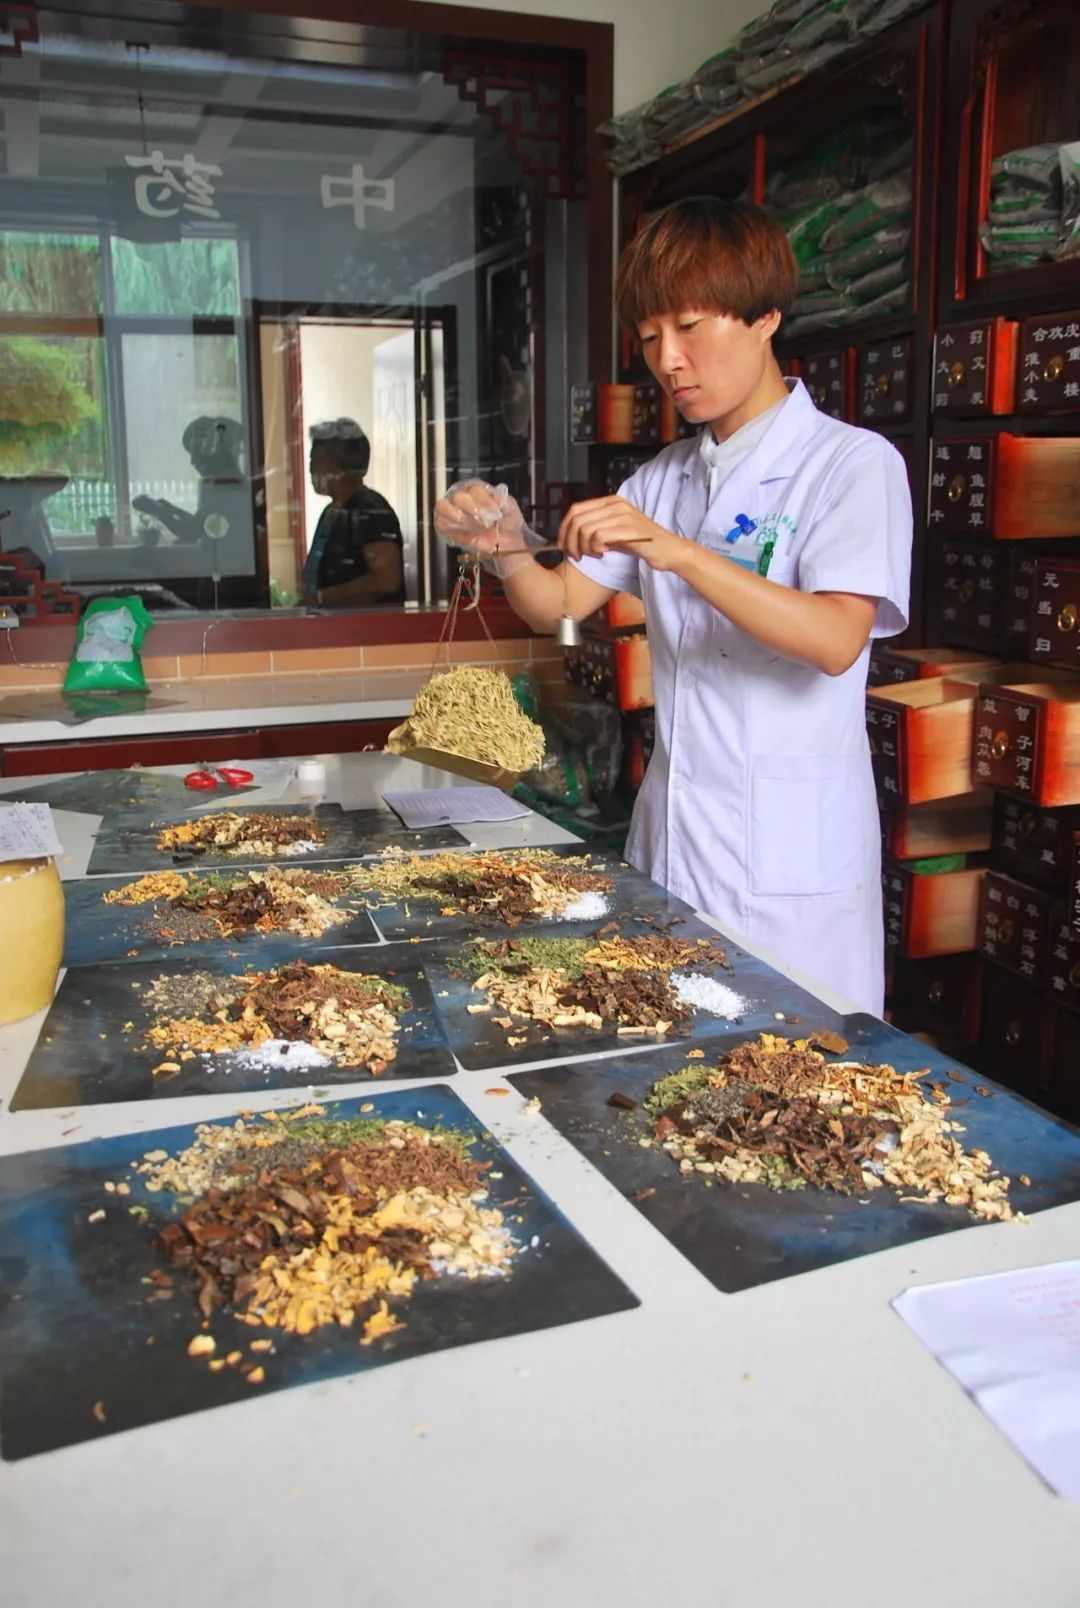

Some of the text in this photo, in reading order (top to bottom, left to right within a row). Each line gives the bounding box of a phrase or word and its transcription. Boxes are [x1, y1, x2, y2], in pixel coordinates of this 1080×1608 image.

[940, 330, 984, 347] 小蓟
[1032, 323, 1080, 342] 合欢皮
[1023, 352, 1040, 402] 淮小麦
[968, 473, 986, 527] 鱼腥草
[1034, 600, 1052, 653] 当归
